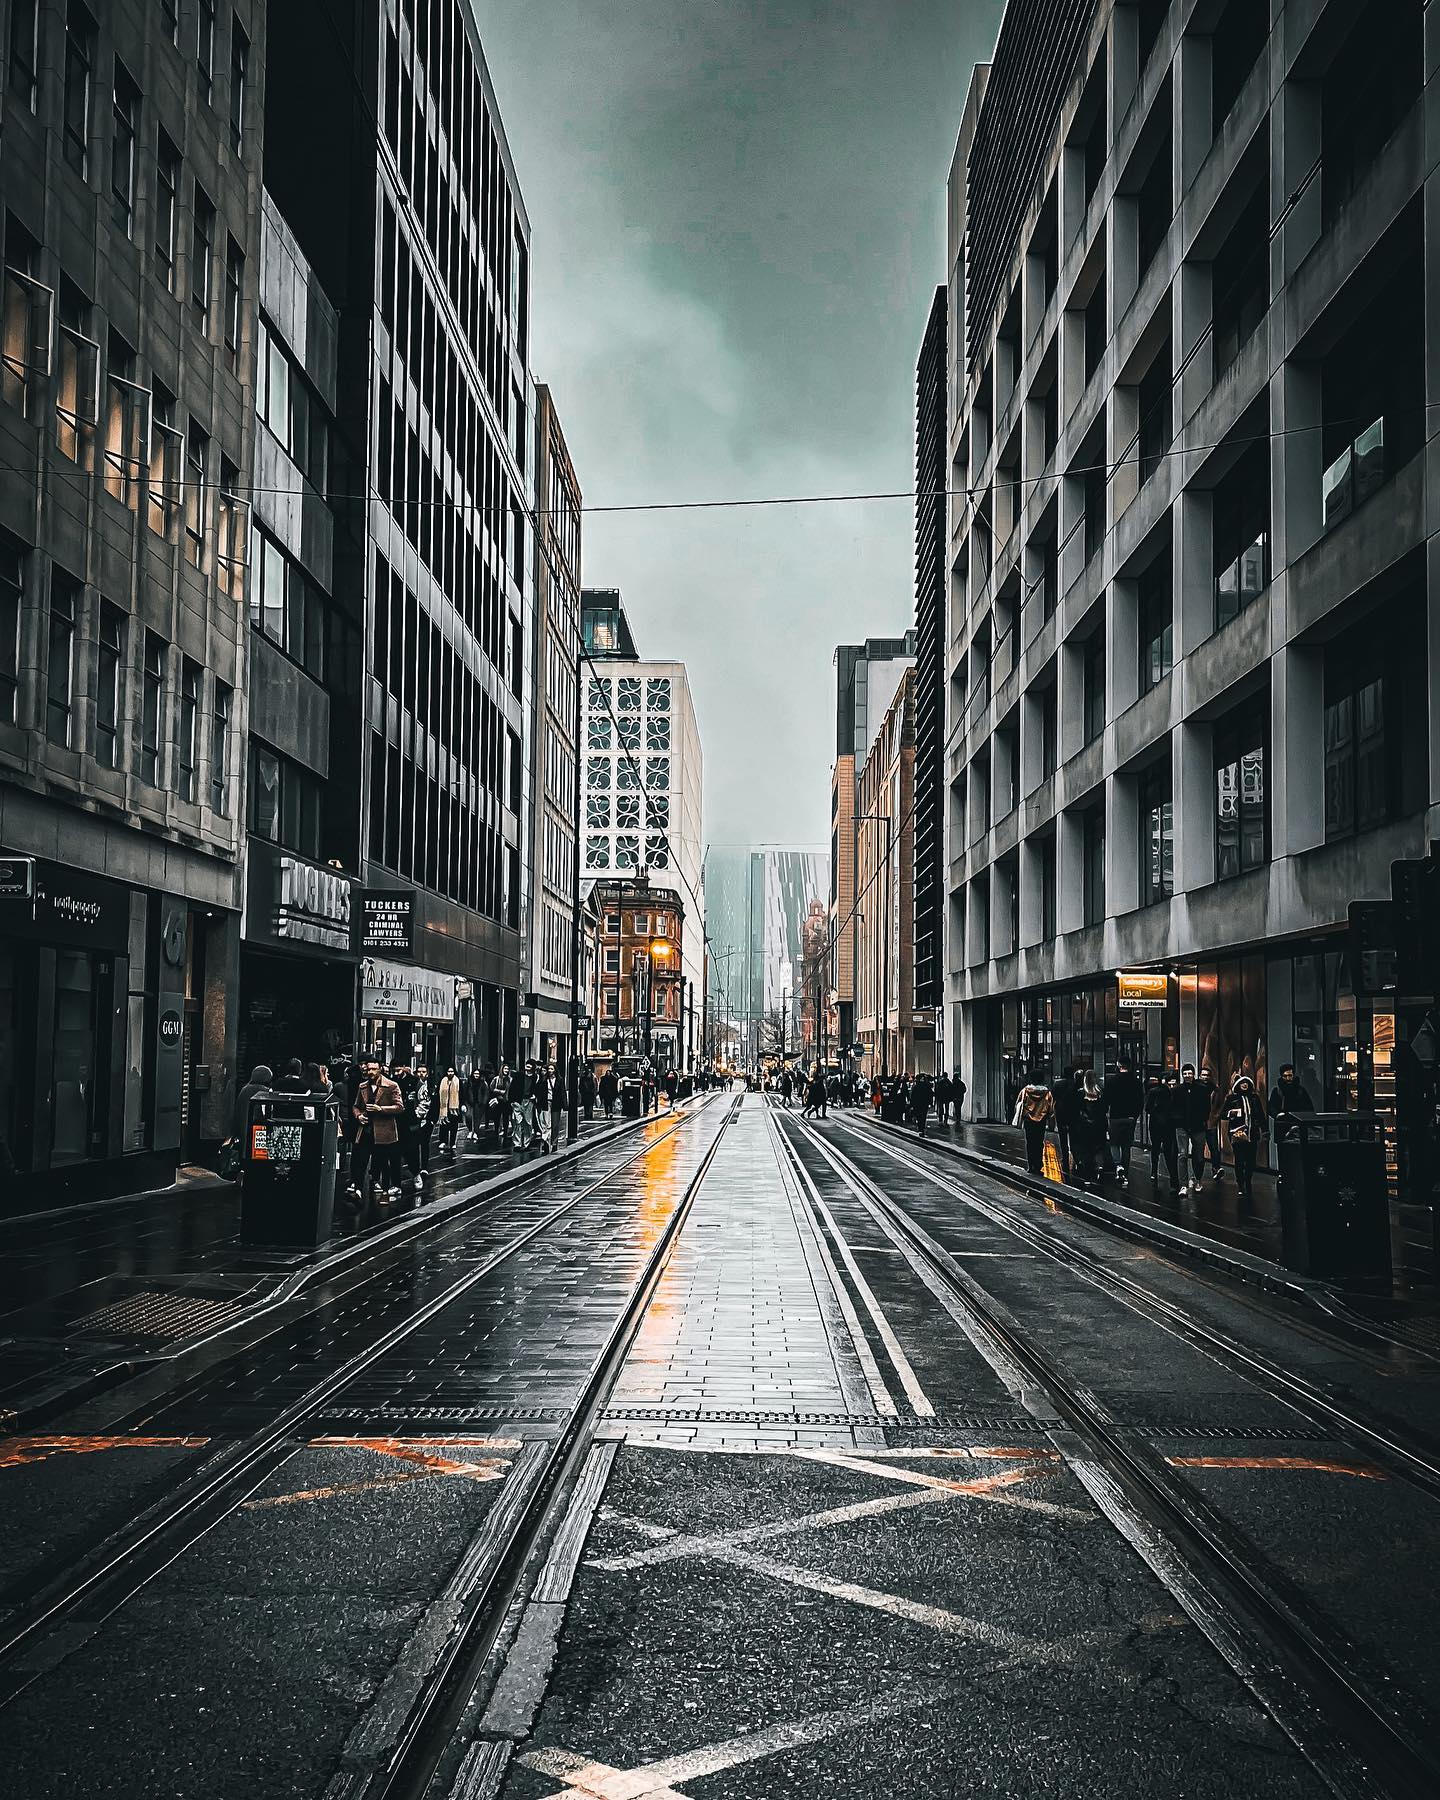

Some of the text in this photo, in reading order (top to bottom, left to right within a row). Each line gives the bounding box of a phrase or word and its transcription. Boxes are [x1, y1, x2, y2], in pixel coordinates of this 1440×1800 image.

[364, 900, 410, 910] TUCKERS
[376, 913, 398, 921] 24 HR
[369, 921, 404, 929] CRIMINAL
[369, 929, 403, 937] LAWYERS
